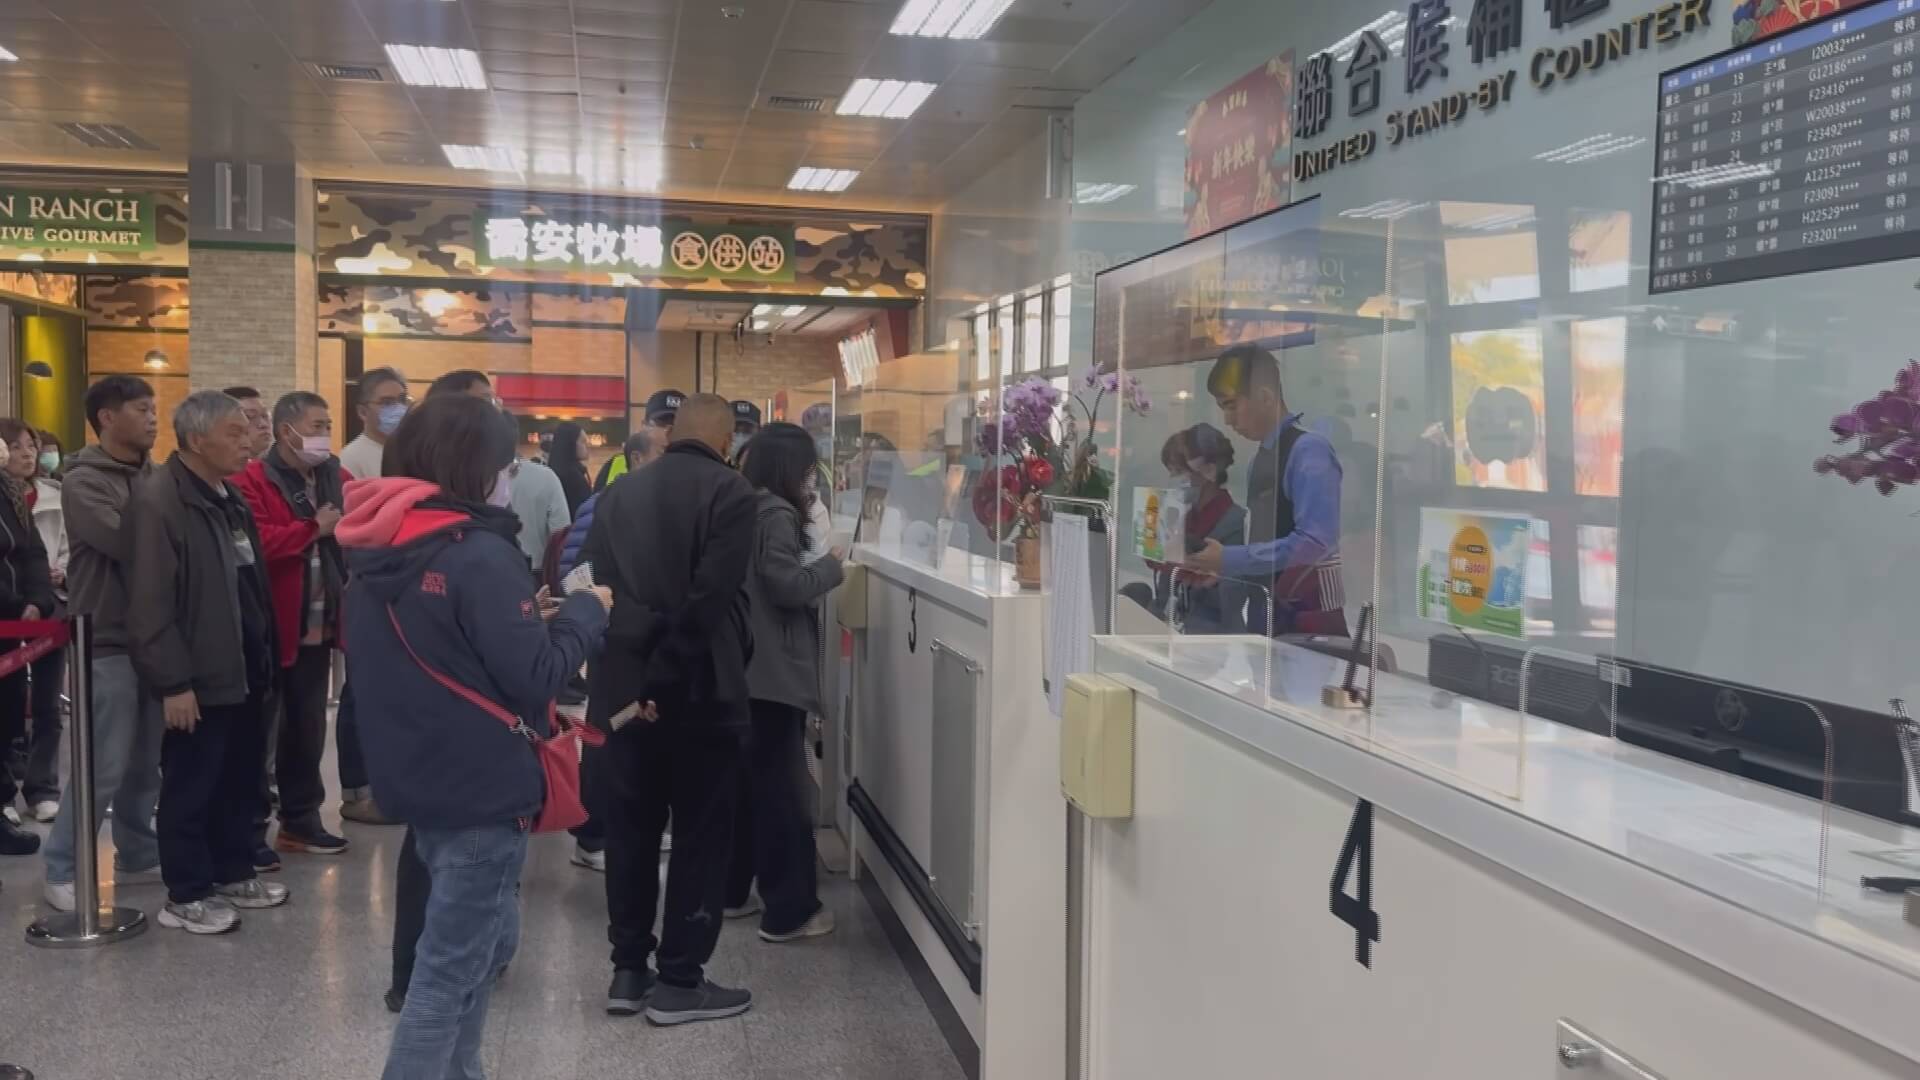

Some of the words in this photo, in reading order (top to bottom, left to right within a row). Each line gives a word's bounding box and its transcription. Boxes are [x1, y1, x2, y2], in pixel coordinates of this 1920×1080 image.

[1293, 130, 1376, 182] UNIFIED
[1385, 70, 1517, 145] STAND-BY
[1530, 0, 1711, 90] COUNTER
[1294, 0, 1610, 139] 聯合候補
[28, 196, 140, 223] RANCH
[43, 228, 142, 246] GOURMET
[1329, 797, 1381, 969] 4
